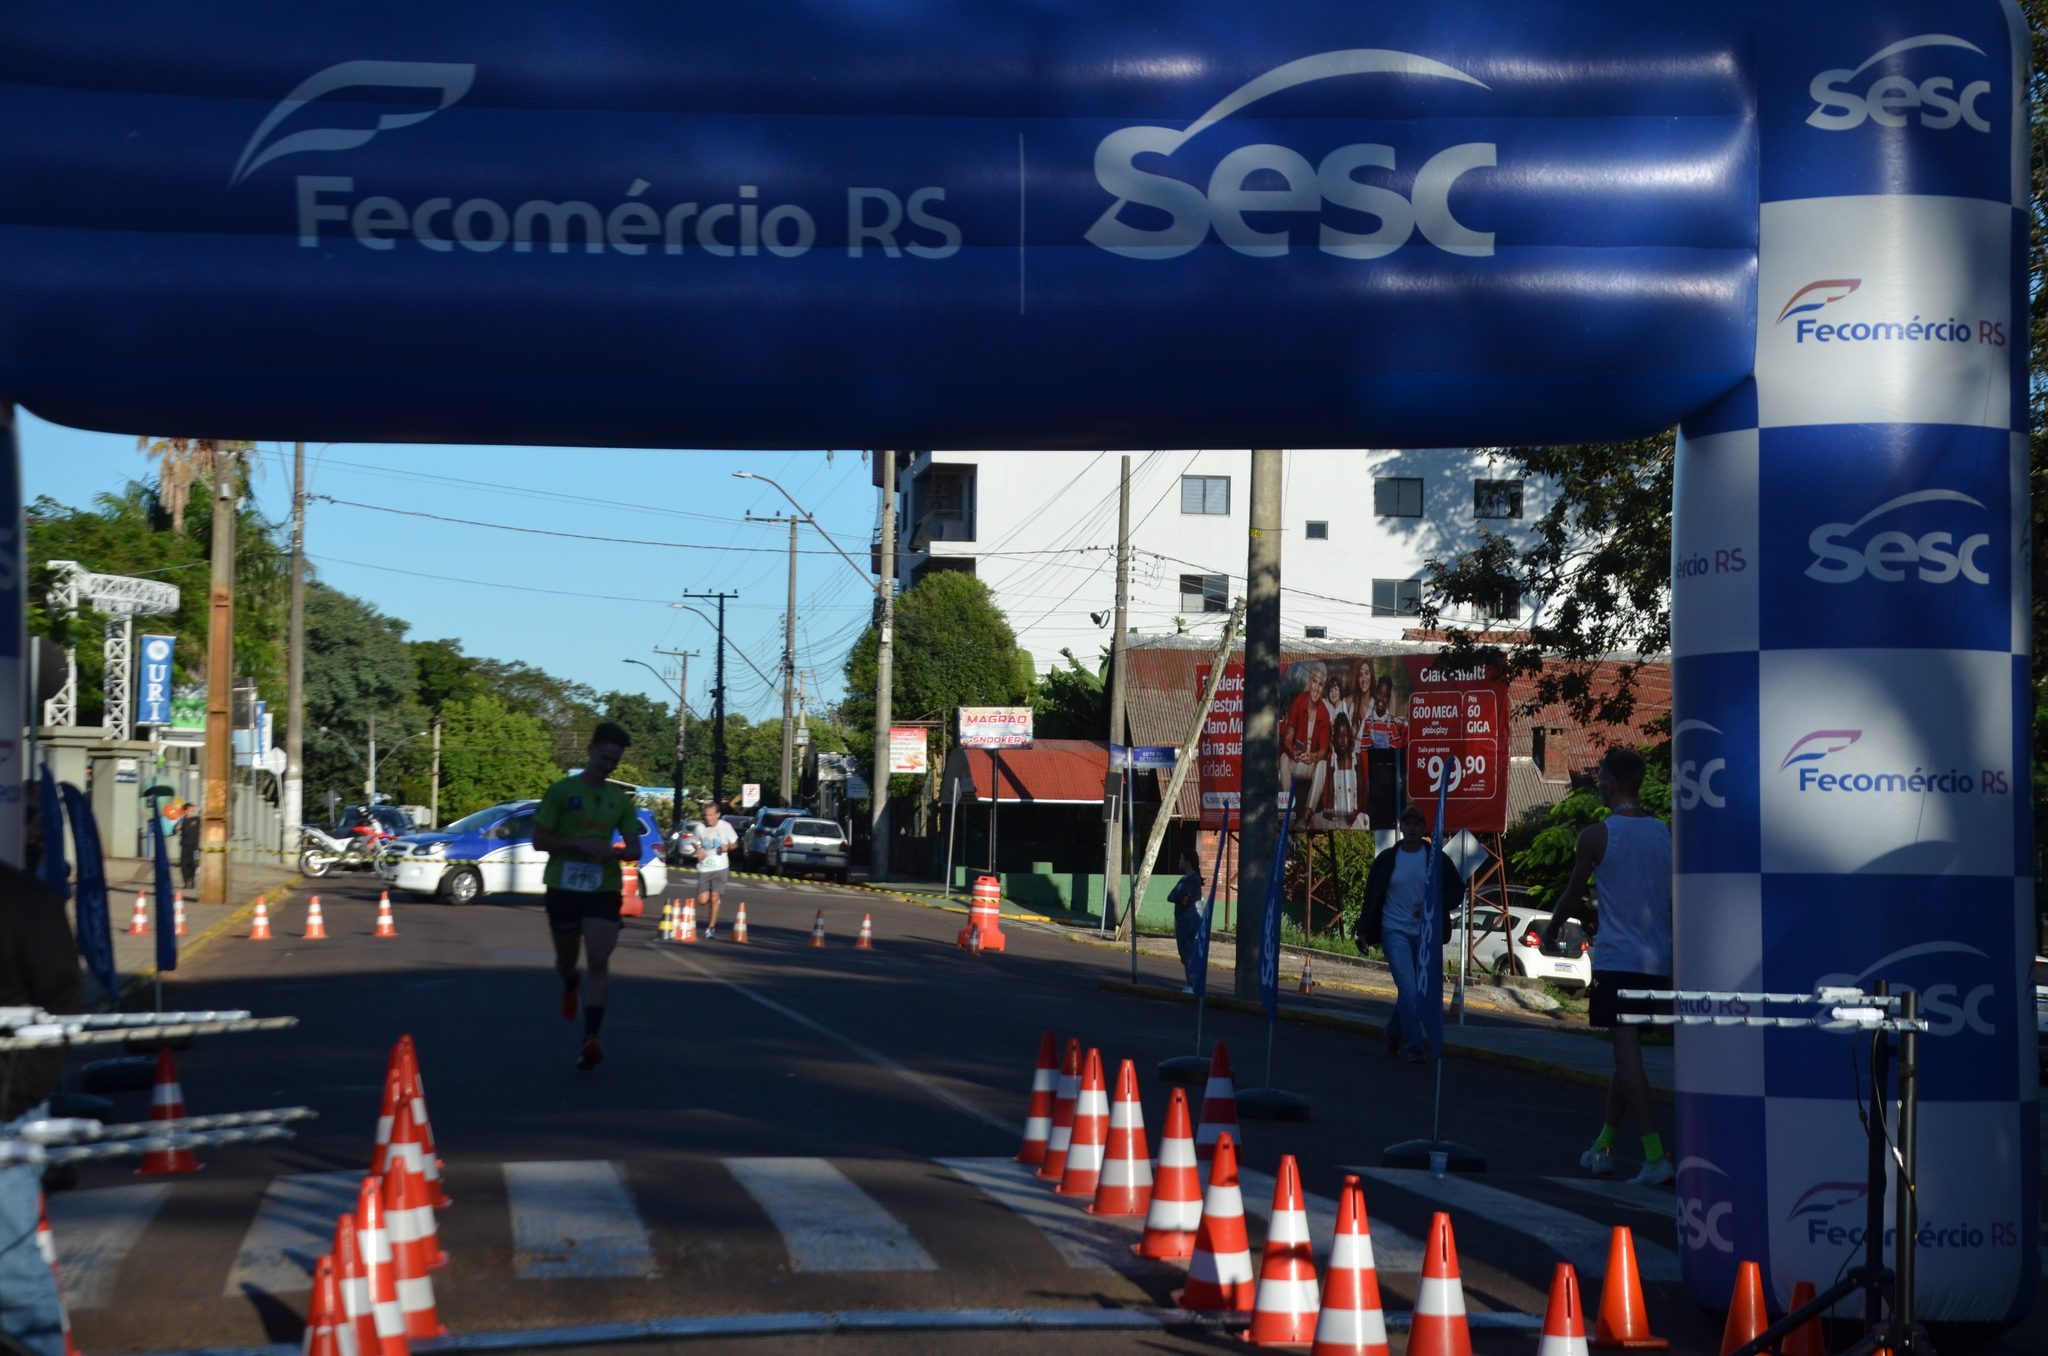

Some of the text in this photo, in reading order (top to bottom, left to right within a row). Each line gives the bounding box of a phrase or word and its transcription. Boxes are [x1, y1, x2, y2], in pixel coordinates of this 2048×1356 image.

[1805, 34, 1991, 133] Sesc
[1083, 48, 1497, 260] Sesc
[297, 176, 962, 259] Fecomércio RS
[1796, 316, 2006, 346] Fecomércio RS
[1804, 489, 1990, 585] Sesc
[1676, 547, 1747, 579] ércio RS
[147, 664, 168, 721] URI
[967, 712, 1027, 724] MAGRÃO
[1413, 705, 1458, 719] 600 MEGA
[1467, 705, 1481, 717] 60
[972, 736, 1021, 744] SNOOKER
[1466, 720, 1491, 733] GIGA
[1212, 742, 1225, 755] na
[1417, 757, 1426, 769] R$
[1203, 760, 1235, 776] cidade.
[1799, 766, 2009, 795] Fecomércio RS
[1672, 757, 1726, 811] esc
[1677, 1190, 1734, 1254] esc
[1808, 1220, 2017, 1248] Fecércio RS
